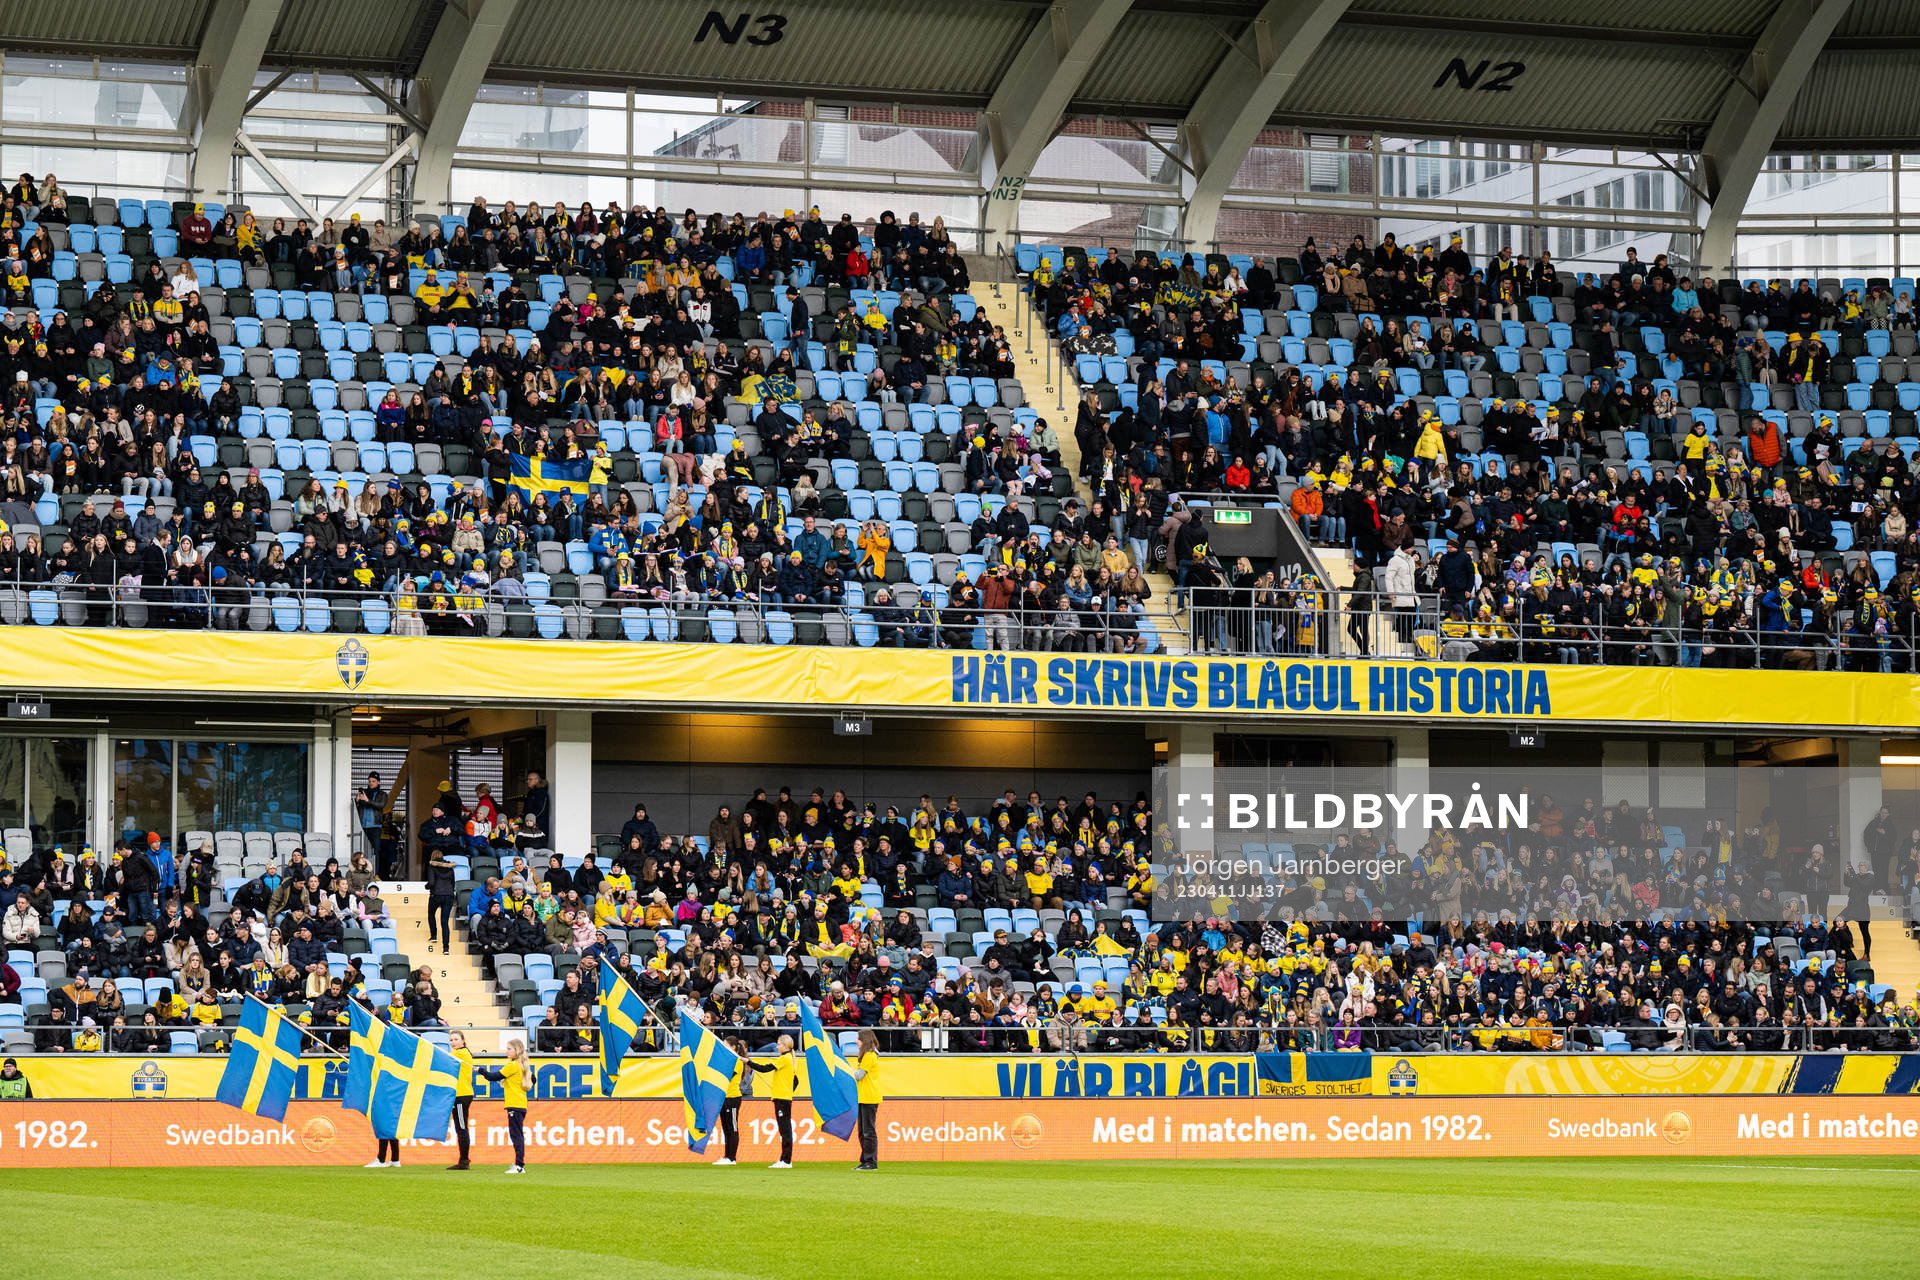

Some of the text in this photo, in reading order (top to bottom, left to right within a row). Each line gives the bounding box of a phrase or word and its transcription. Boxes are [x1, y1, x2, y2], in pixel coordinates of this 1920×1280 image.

[692, 11, 788, 46] N3
[1432, 58, 1526, 91] N2
[1000, 176, 1022, 188] N2
[995, 188, 1018, 201] N3
[997, 302, 1007, 310] 13
[1013, 330, 1023, 338] 12
[1044, 386, 1054, 394] 10
[952, 653, 1551, 715] HÄR SKRIVS BLÅGUL HISTORIA
[21, 705, 38, 716] M4
[845, 723, 860, 733] M3
[1520, 736, 1535, 746] M2
[997, 1063, 1042, 1097] VI
[1054, 1059, 1113, 1097] ÄR
[1265, 1083, 1362, 1096] SVERIGES STOLTHET
[15, 1120, 98, 1149] 1982.
[166, 1123, 295, 1146] Swedbank
[887, 1121, 1006, 1142] Swedbank
[1092, 1115, 1491, 1143] Med i matchen. Sedan 1982.
[1548, 1118, 1657, 1138] Swedbank
[1737, 1113, 1794, 1139] Med
[1803, 1113, 1809, 1138] i
